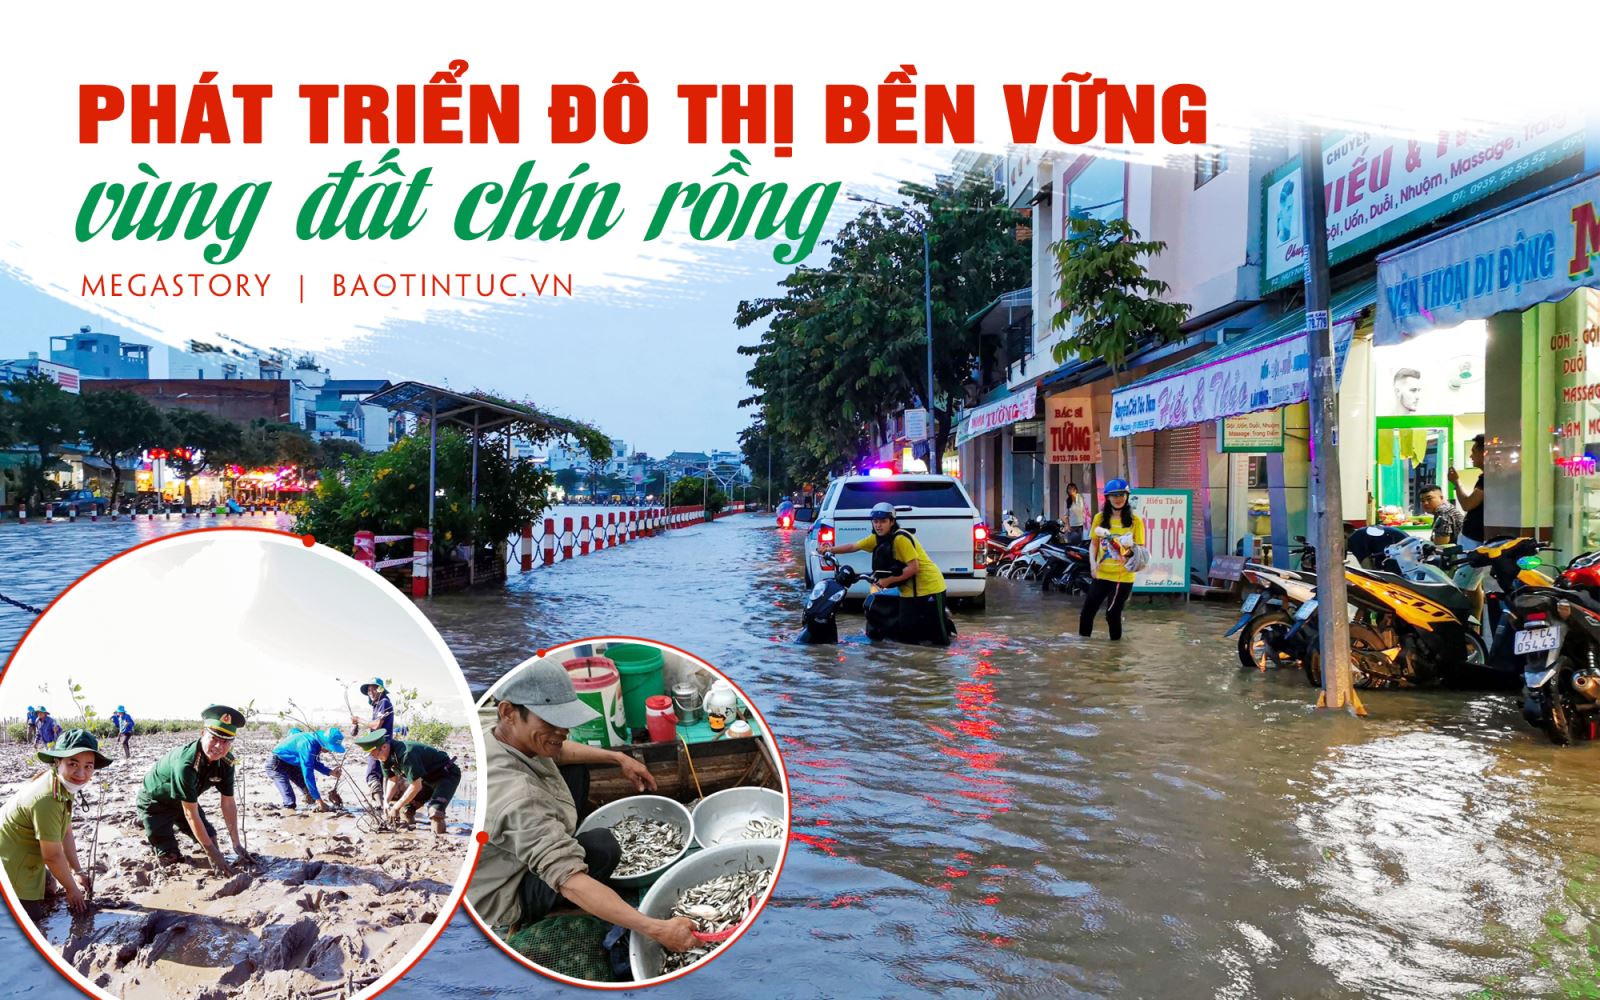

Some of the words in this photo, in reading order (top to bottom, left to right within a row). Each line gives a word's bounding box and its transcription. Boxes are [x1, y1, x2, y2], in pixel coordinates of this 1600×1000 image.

[1421, 261, 1469, 310] THOẠI
[1474, 253, 1494, 297] DI
[1500, 230, 1555, 294] ĐỘNG
[1161, 506, 1184, 559] TÓC
[1517, 638, 1556, 652] 054.43
